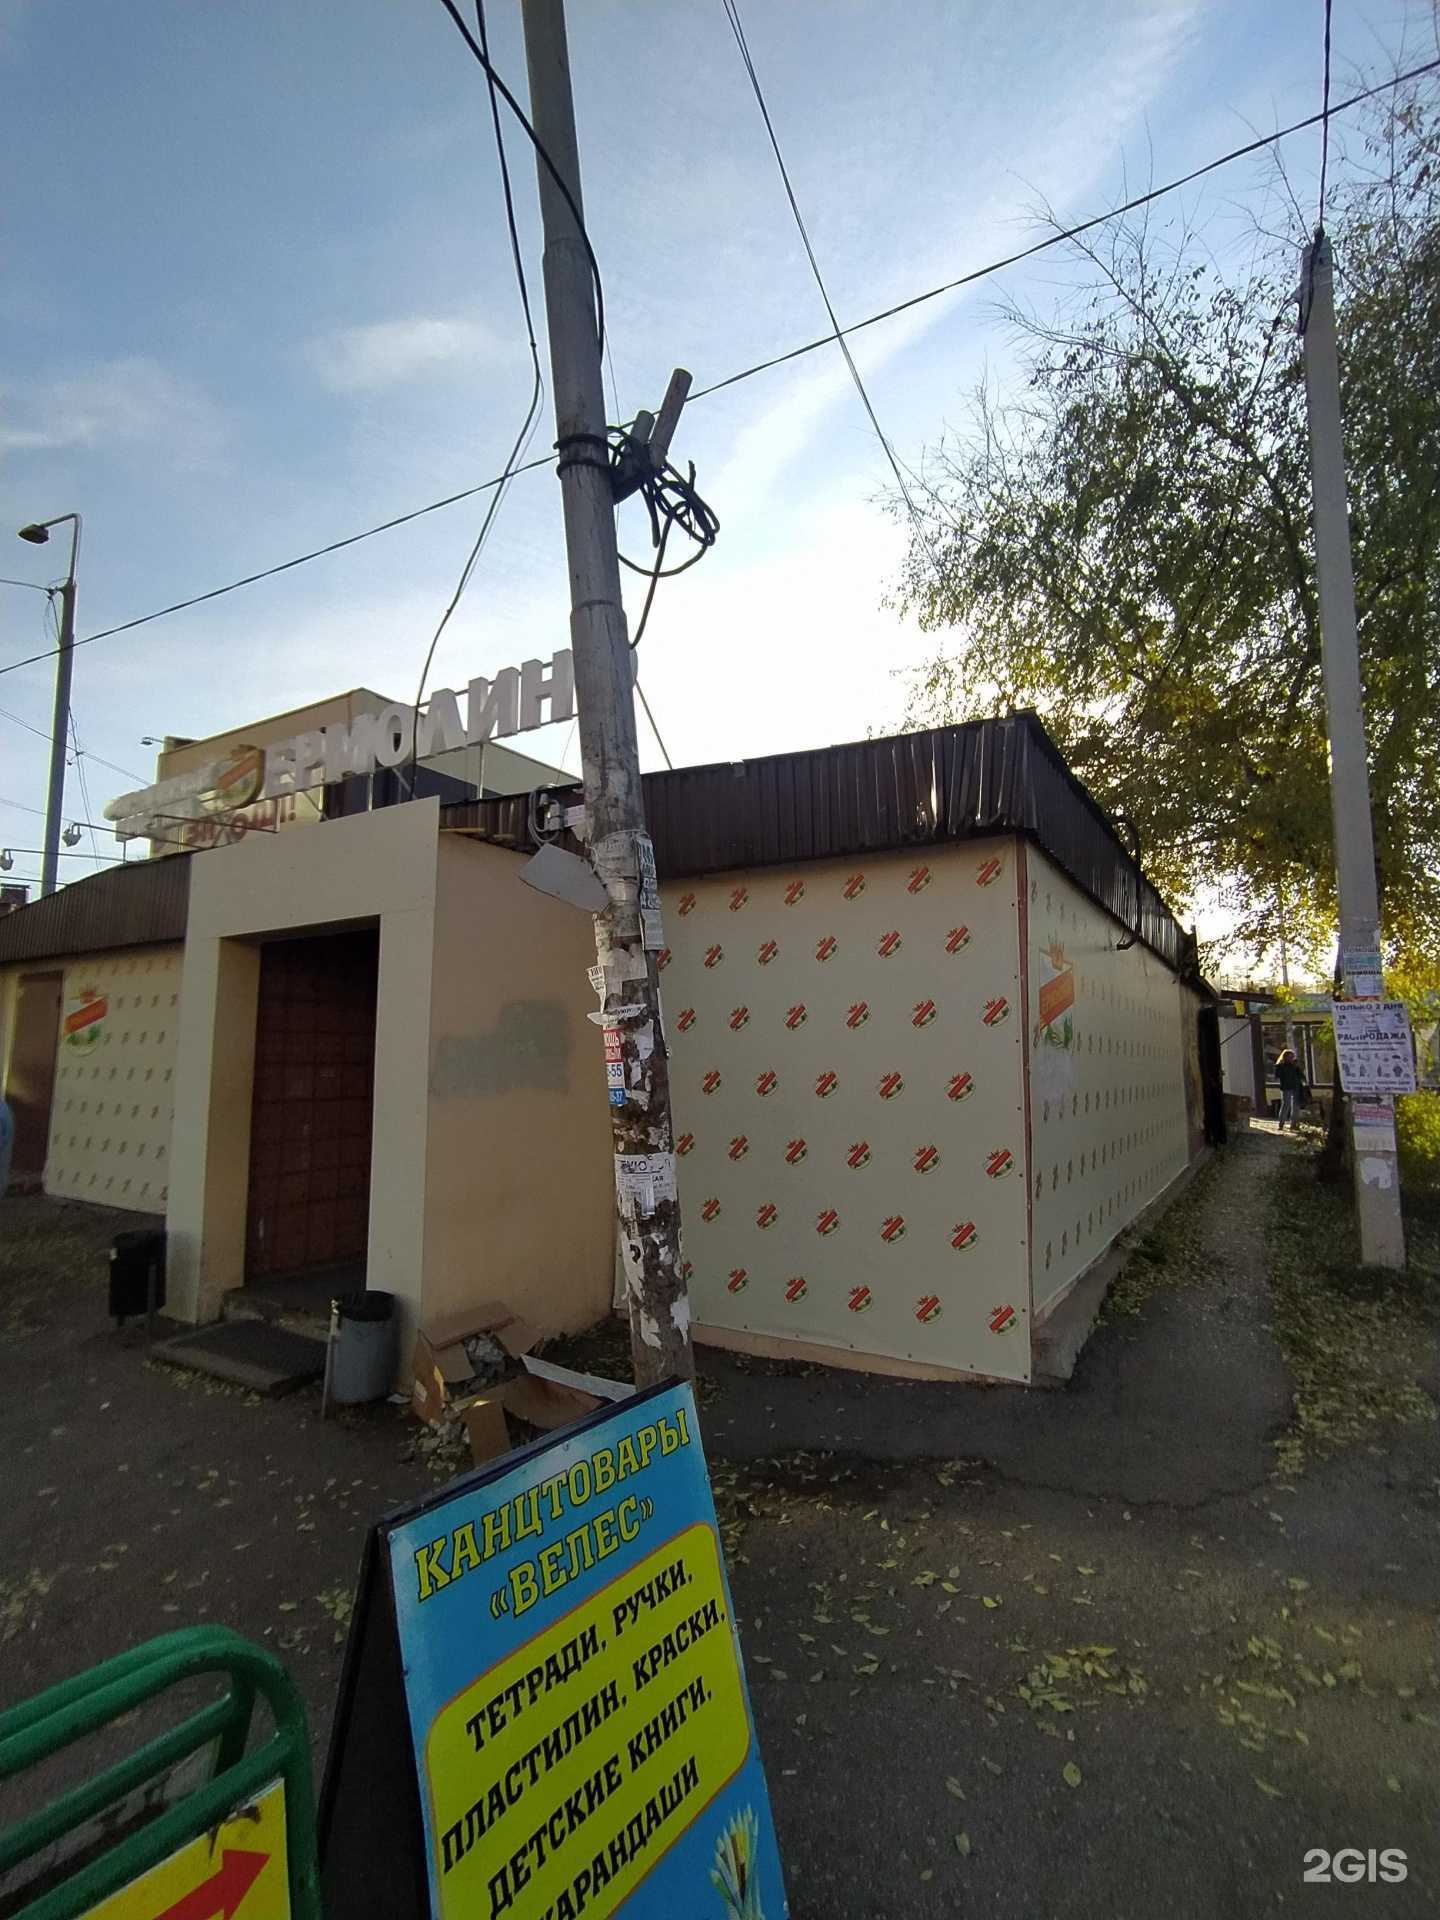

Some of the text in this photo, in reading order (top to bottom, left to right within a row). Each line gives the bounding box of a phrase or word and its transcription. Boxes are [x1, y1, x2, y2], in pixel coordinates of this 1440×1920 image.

[264, 648, 638, 797] ЕРМОЛИН
[414, 1408, 690, 1602] КАНЦТОВАРЫ
[489, 1495, 655, 1620] «ВЕЛЕС»
[487, 1754, 623, 1920] ДЕТСКИЕ
[540, 1756, 699, 1920] АРАНДАШИ
